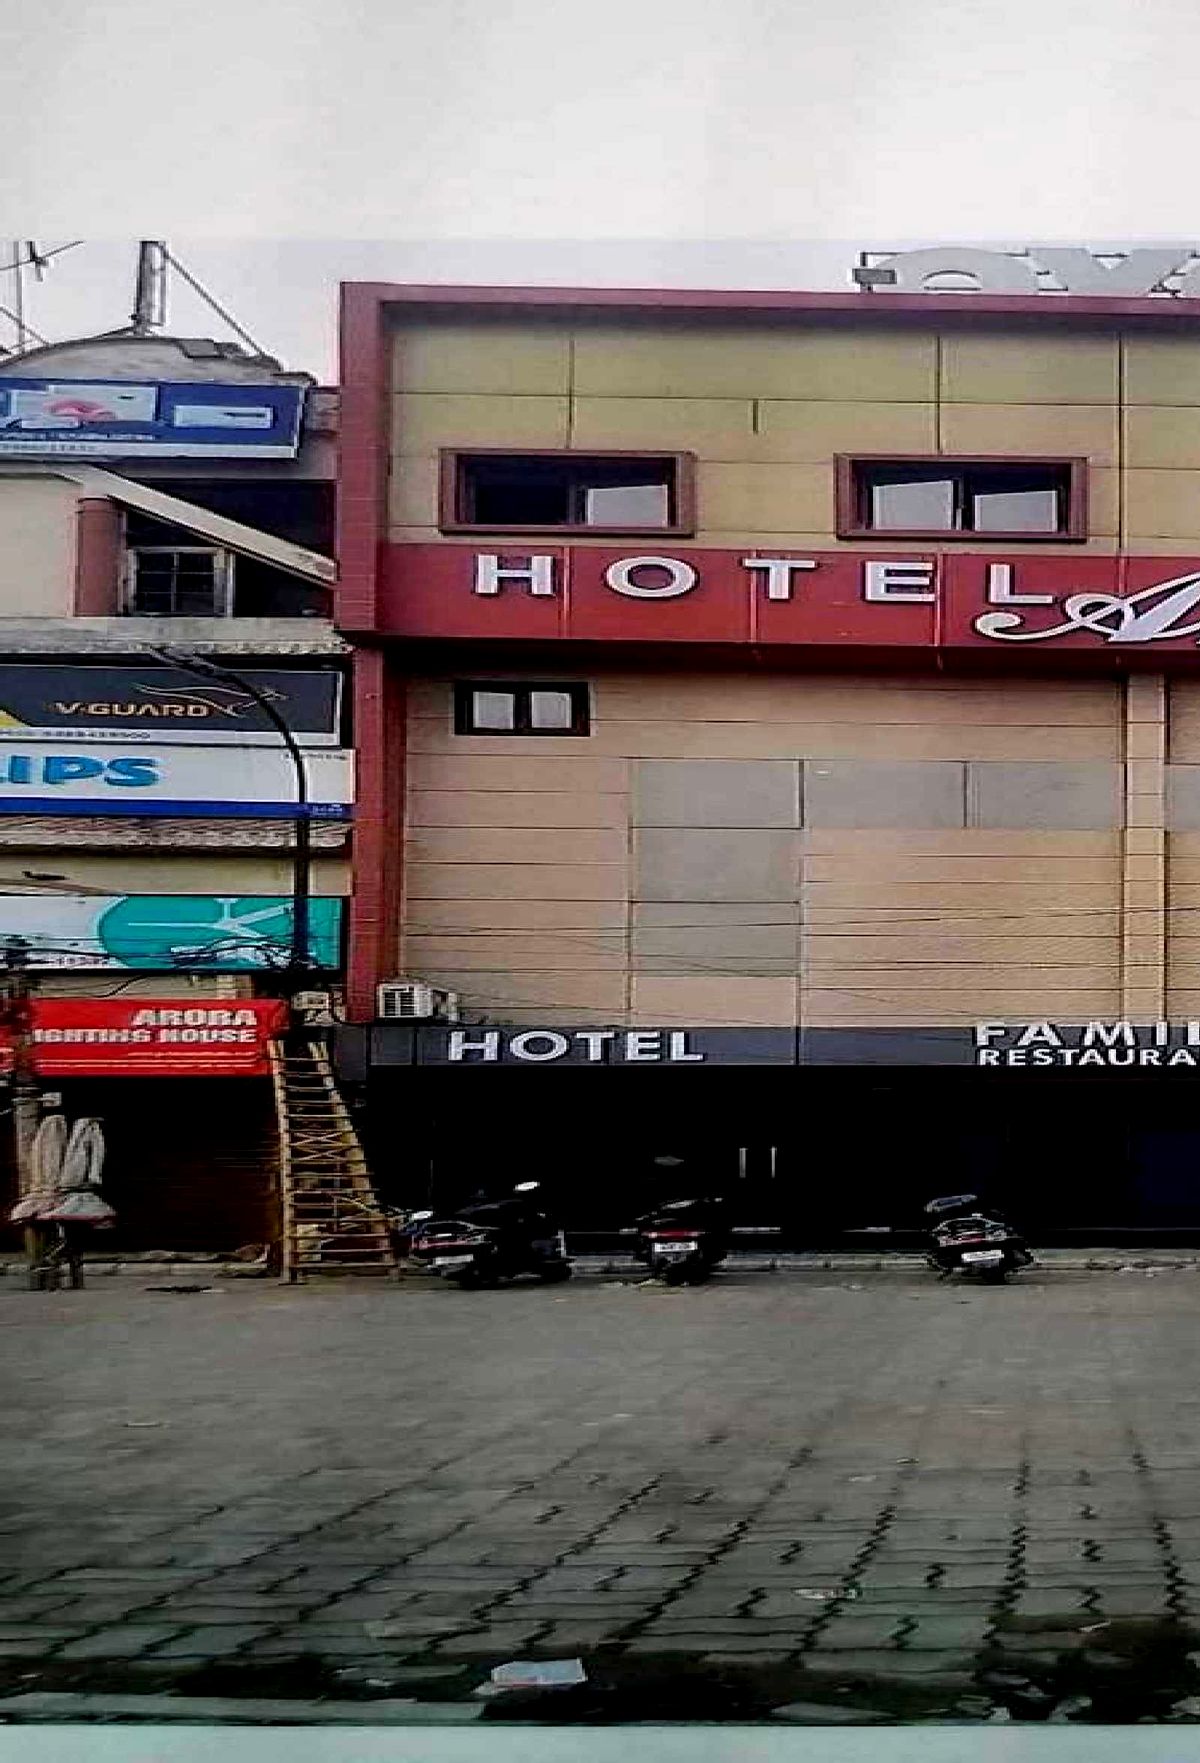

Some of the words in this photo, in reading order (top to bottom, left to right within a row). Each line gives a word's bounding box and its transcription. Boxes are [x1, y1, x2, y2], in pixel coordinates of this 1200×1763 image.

[473, 554, 1056, 603] HOTEL
[55, 702, 211, 718] V-GUARD
[0, 754, 161, 787] IPS
[130, 1008, 258, 1027] ARORA
[33, 1028, 151, 1044] IGHTING
[158, 1028, 257, 1044] HOUSE
[447, 1030, 704, 1062] HOTEL
